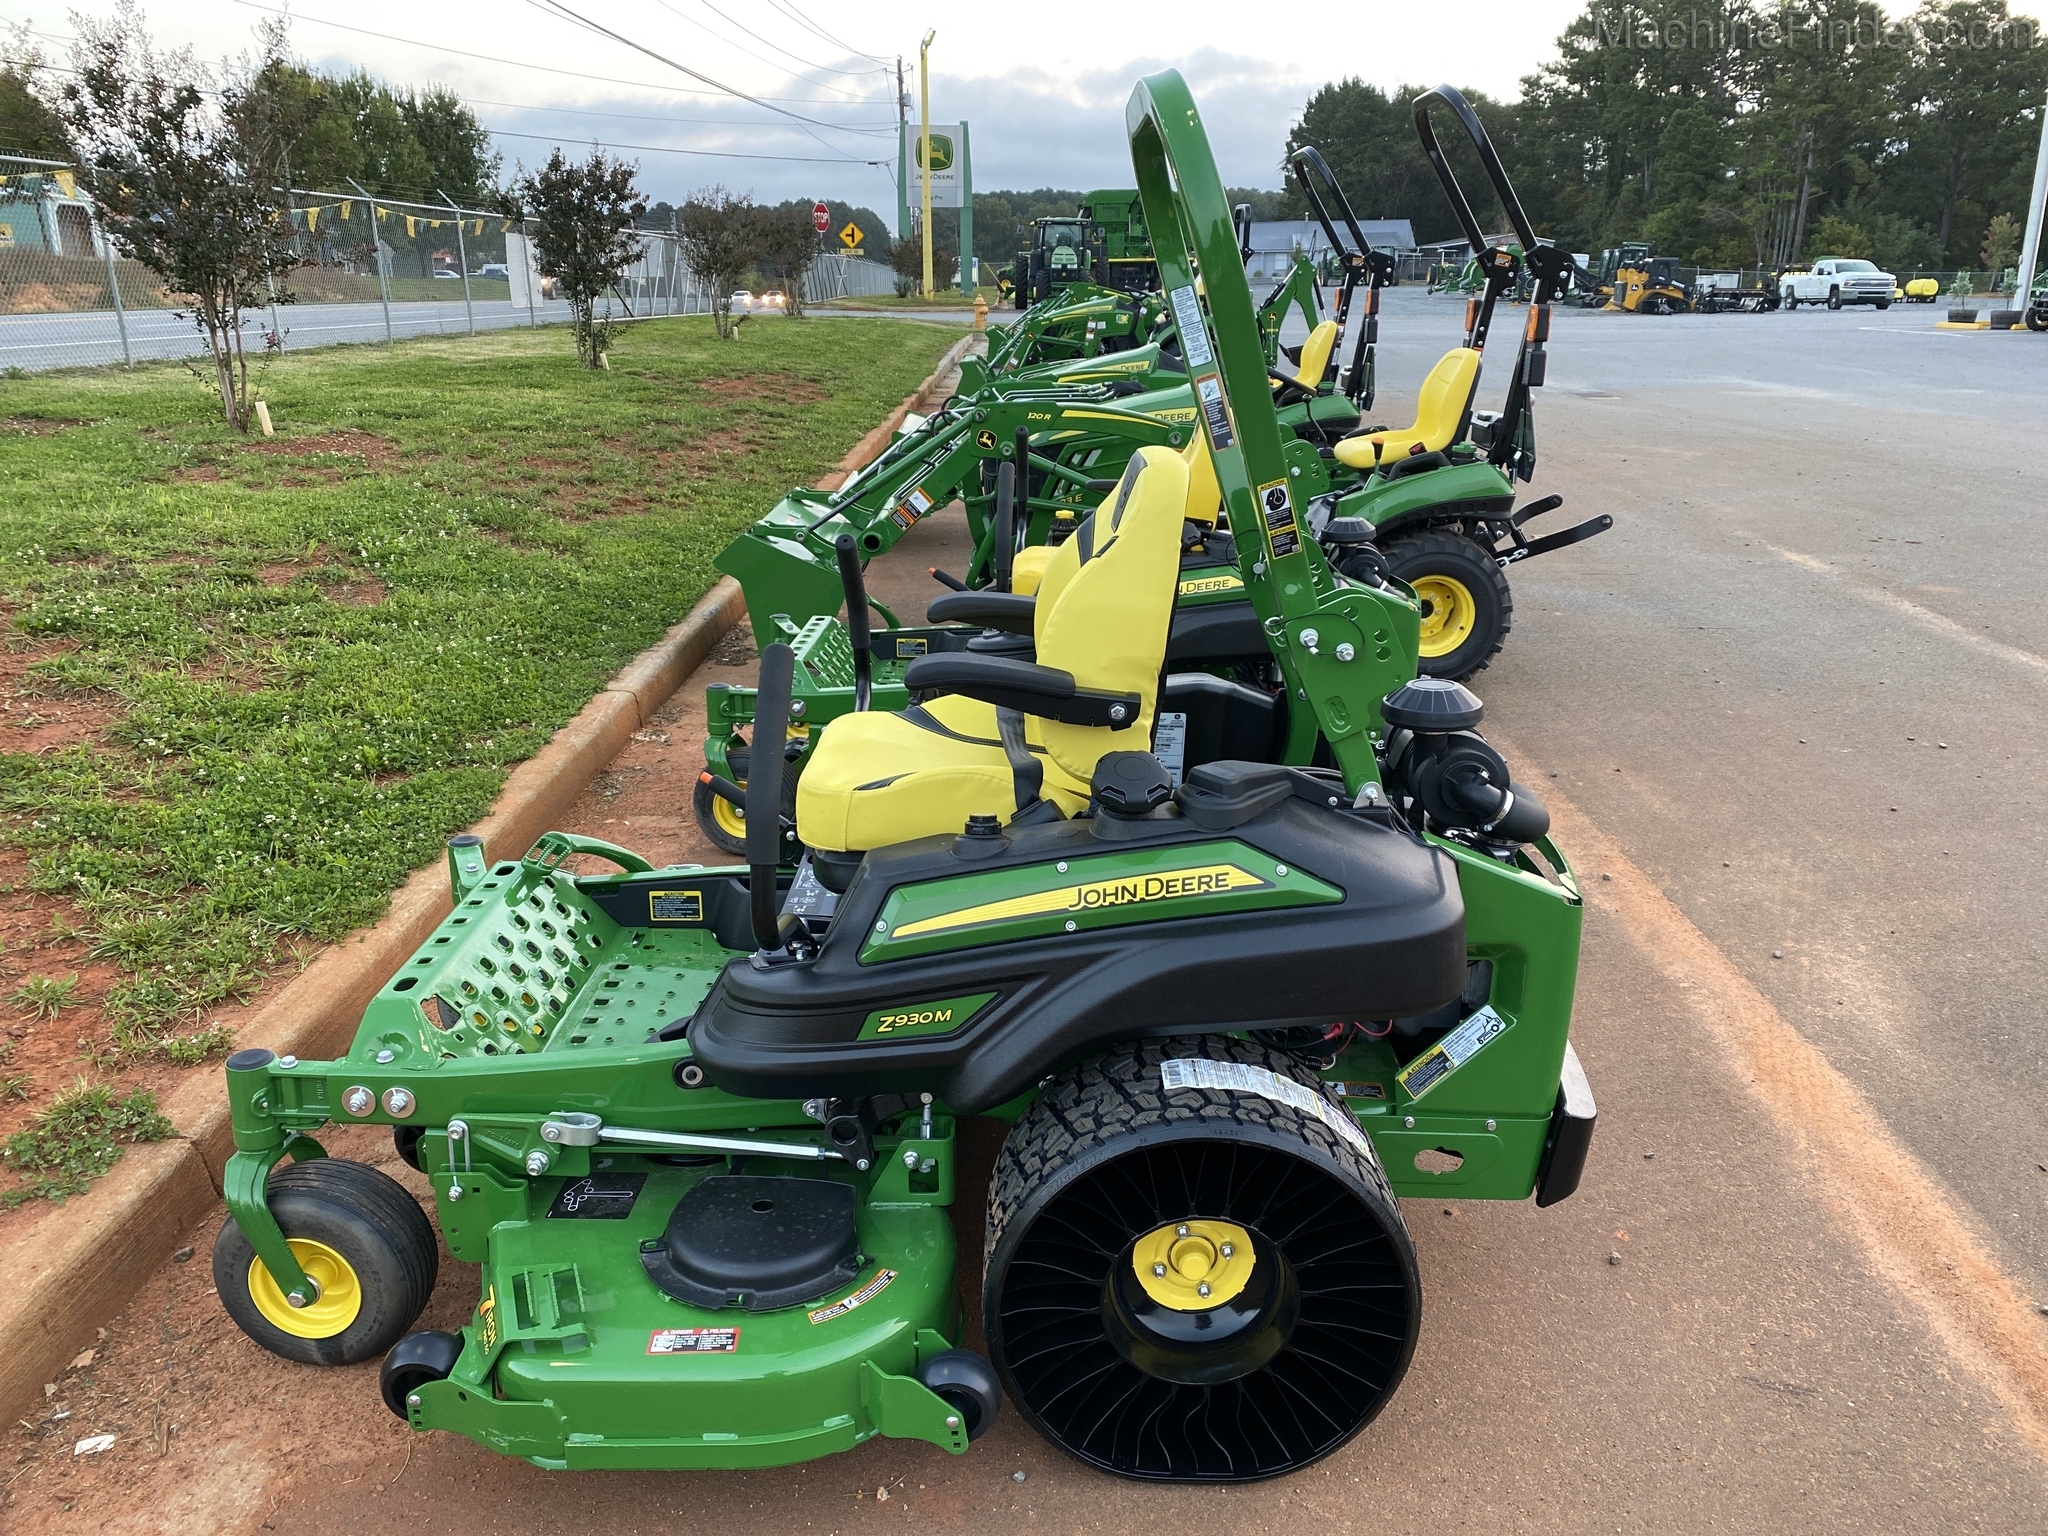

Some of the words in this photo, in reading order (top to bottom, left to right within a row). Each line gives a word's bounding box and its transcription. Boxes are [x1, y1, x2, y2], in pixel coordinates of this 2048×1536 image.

[813, 212, 829, 223] STOP
[1186, 579, 1230, 593] DEERE
[1068, 883, 1138, 908] JOHN
[1145, 872, 1230, 898] DEERE
[877, 1009, 952, 1033] Z930M
[1410, 1051, 1435, 1073] ATENCIÓN
